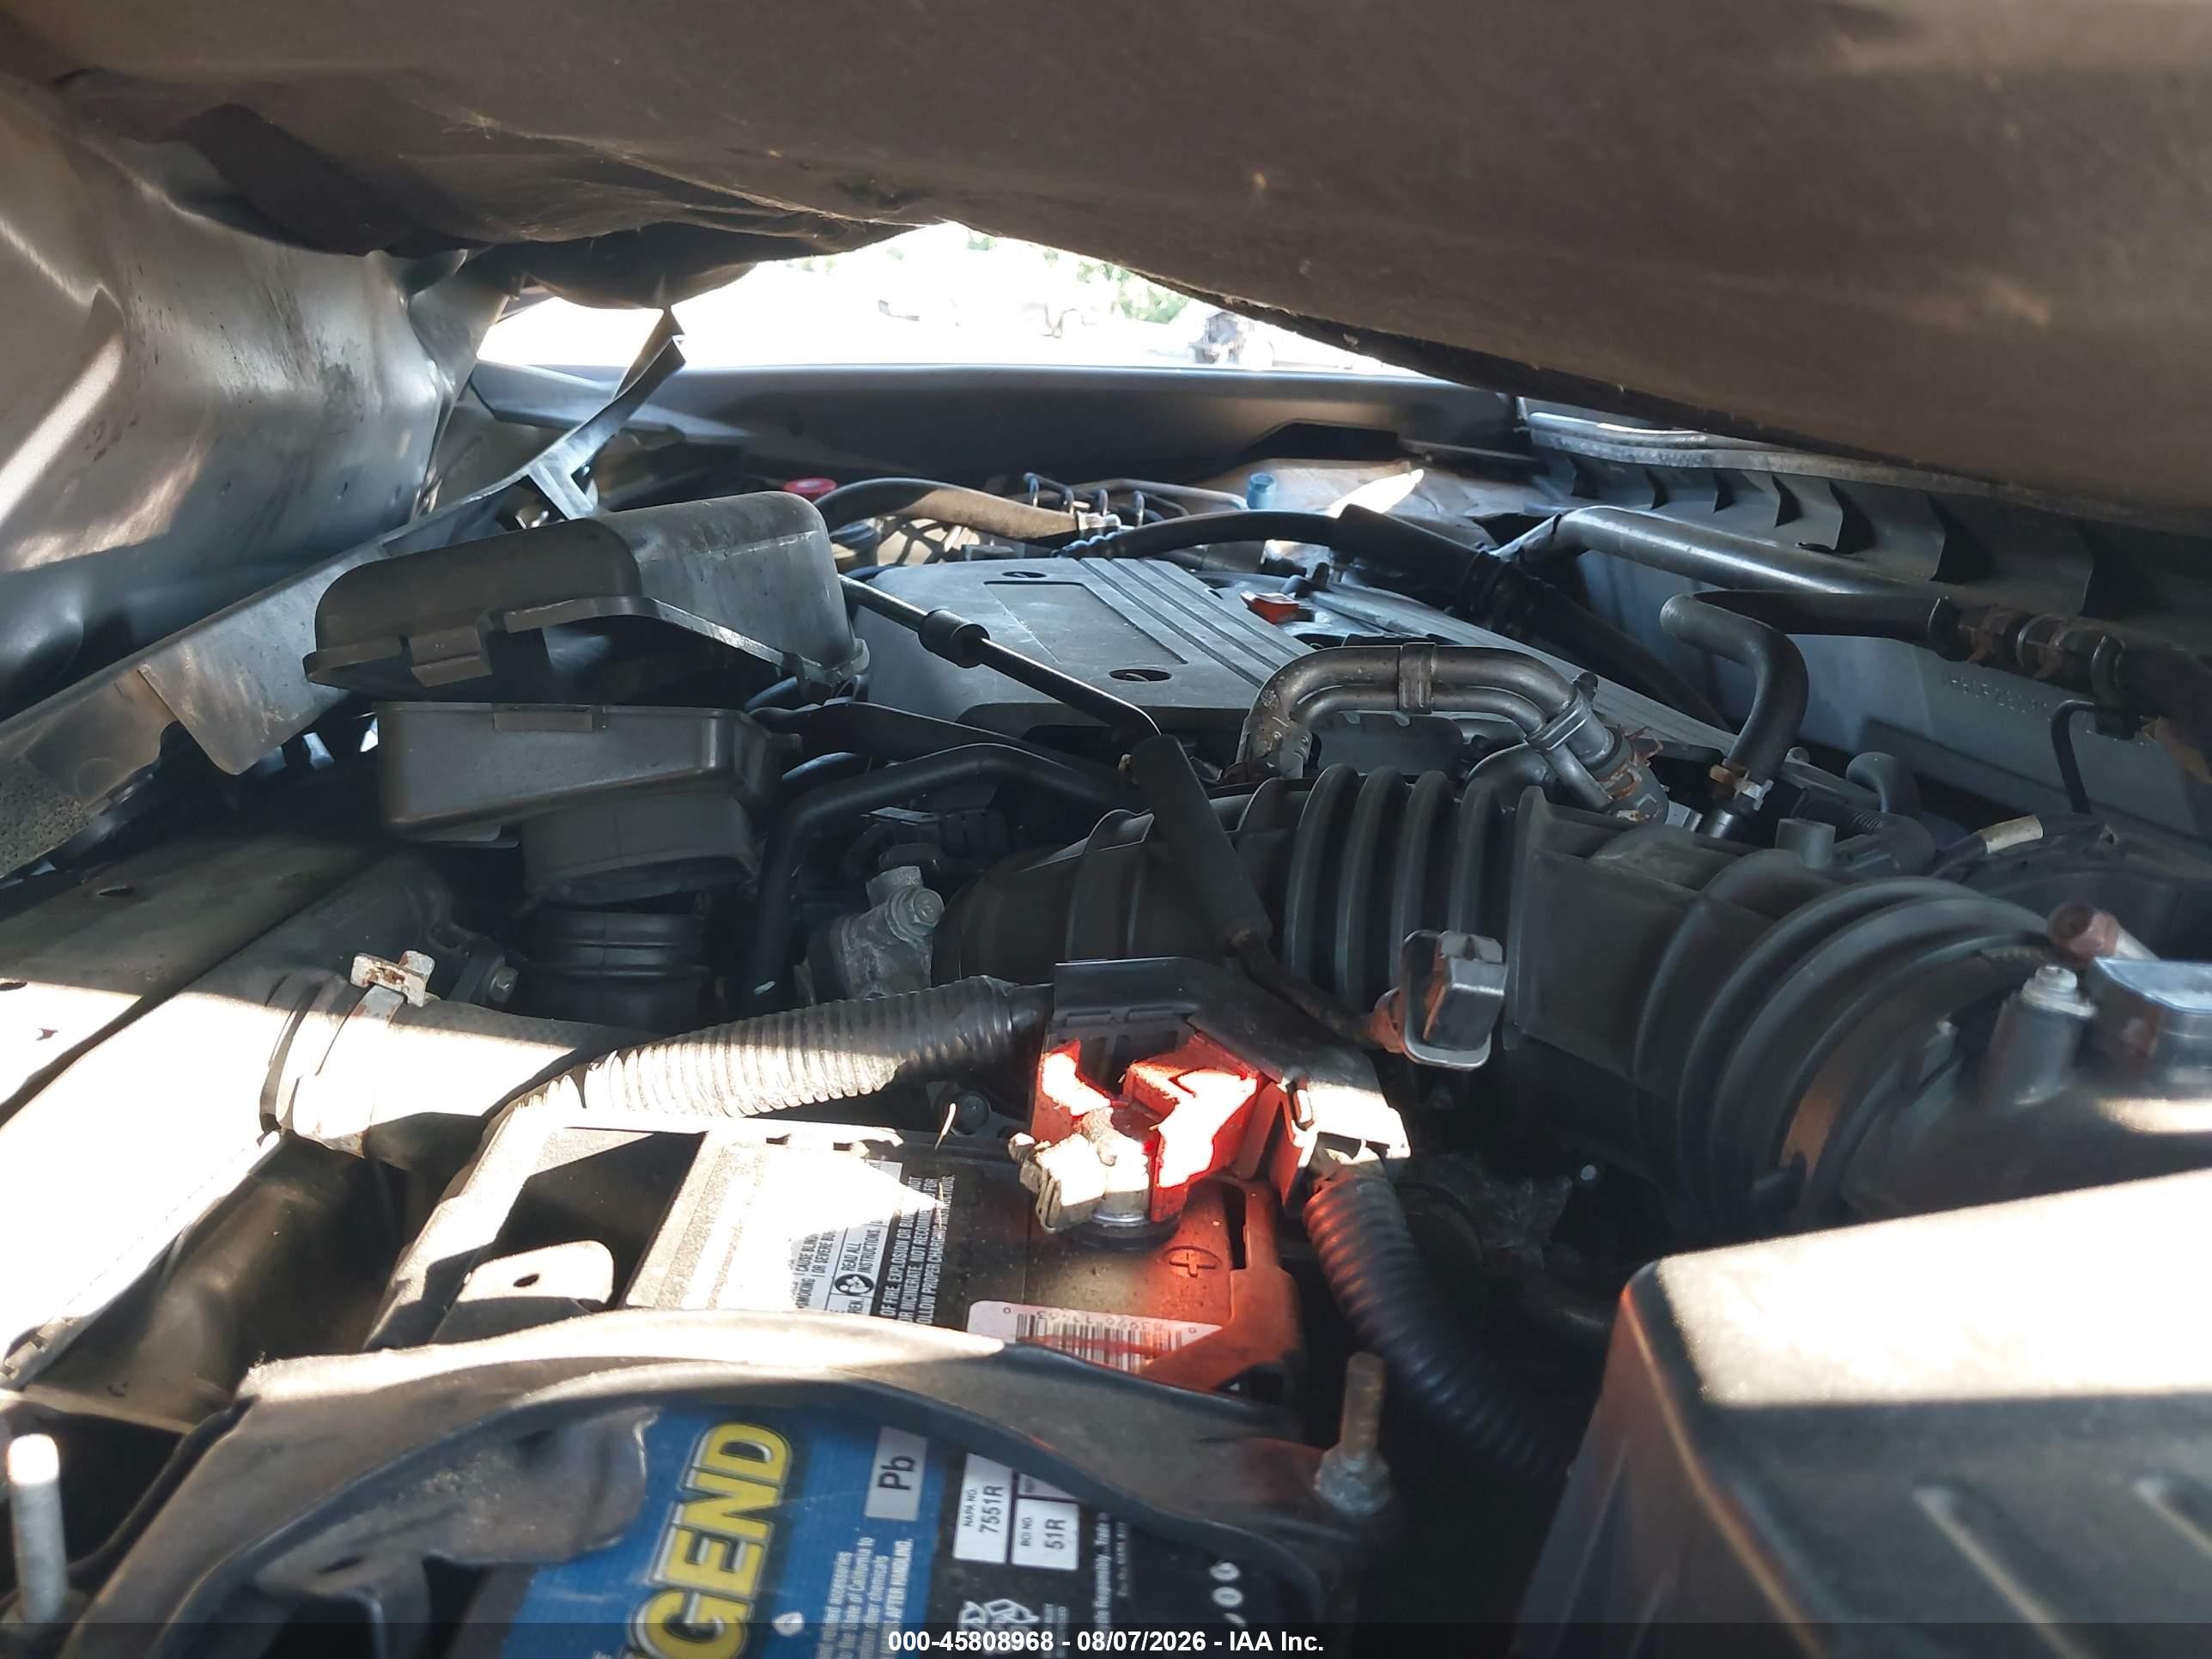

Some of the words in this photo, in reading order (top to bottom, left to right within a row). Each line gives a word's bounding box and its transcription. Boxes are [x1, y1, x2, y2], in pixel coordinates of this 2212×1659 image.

[924, 1177, 938, 1191] FOR
[897, 1228, 912, 1239] OR
[900, 1213, 915, 1228] BUR
[814, 1242, 833, 1263] SEVERE
[846, 1243, 862, 1254] ALL
[857, 1228, 881, 1273] INSTRUCTIONS.
[911, 1245, 926, 1262] NOT
[928, 1224, 948, 1262] CHARGING
[795, 1253, 813, 1272] CAUSE
[811, 1265, 825, 1273] OR
[841, 1254, 858, 1271] READ
[888, 1239, 909, 1283] EXPLOSION
[901, 1263, 923, 1310] INCINERATE.
[922, 1263, 941, 1295] PROPER
[880, 1304, 896, 1316] OF
[916, 1294, 936, 1324] OLLOW
[878, 1455, 916, 1490] Pb
[963, 1504, 975, 1526] NAPA
[979, 1486, 1003, 1534] 7551R
[631, 1421, 793, 1659] GEND
[858, 1536, 873, 1547] to
[1044, 1519, 1066, 1550] 51R
[848, 1548, 871, 1591] California
[890, 1539, 914, 1586] HANDLING.
[829, 1551, 852, 1605] accessories
[868, 1555, 889, 1602] chemicals
[848, 1593, 863, 1603] of
[886, 1588, 905, 1619] AFTER
[821, 1606, 842, 1641] related
[841, 1606, 860, 1630] State
[864, 1603, 880, 1628] other
